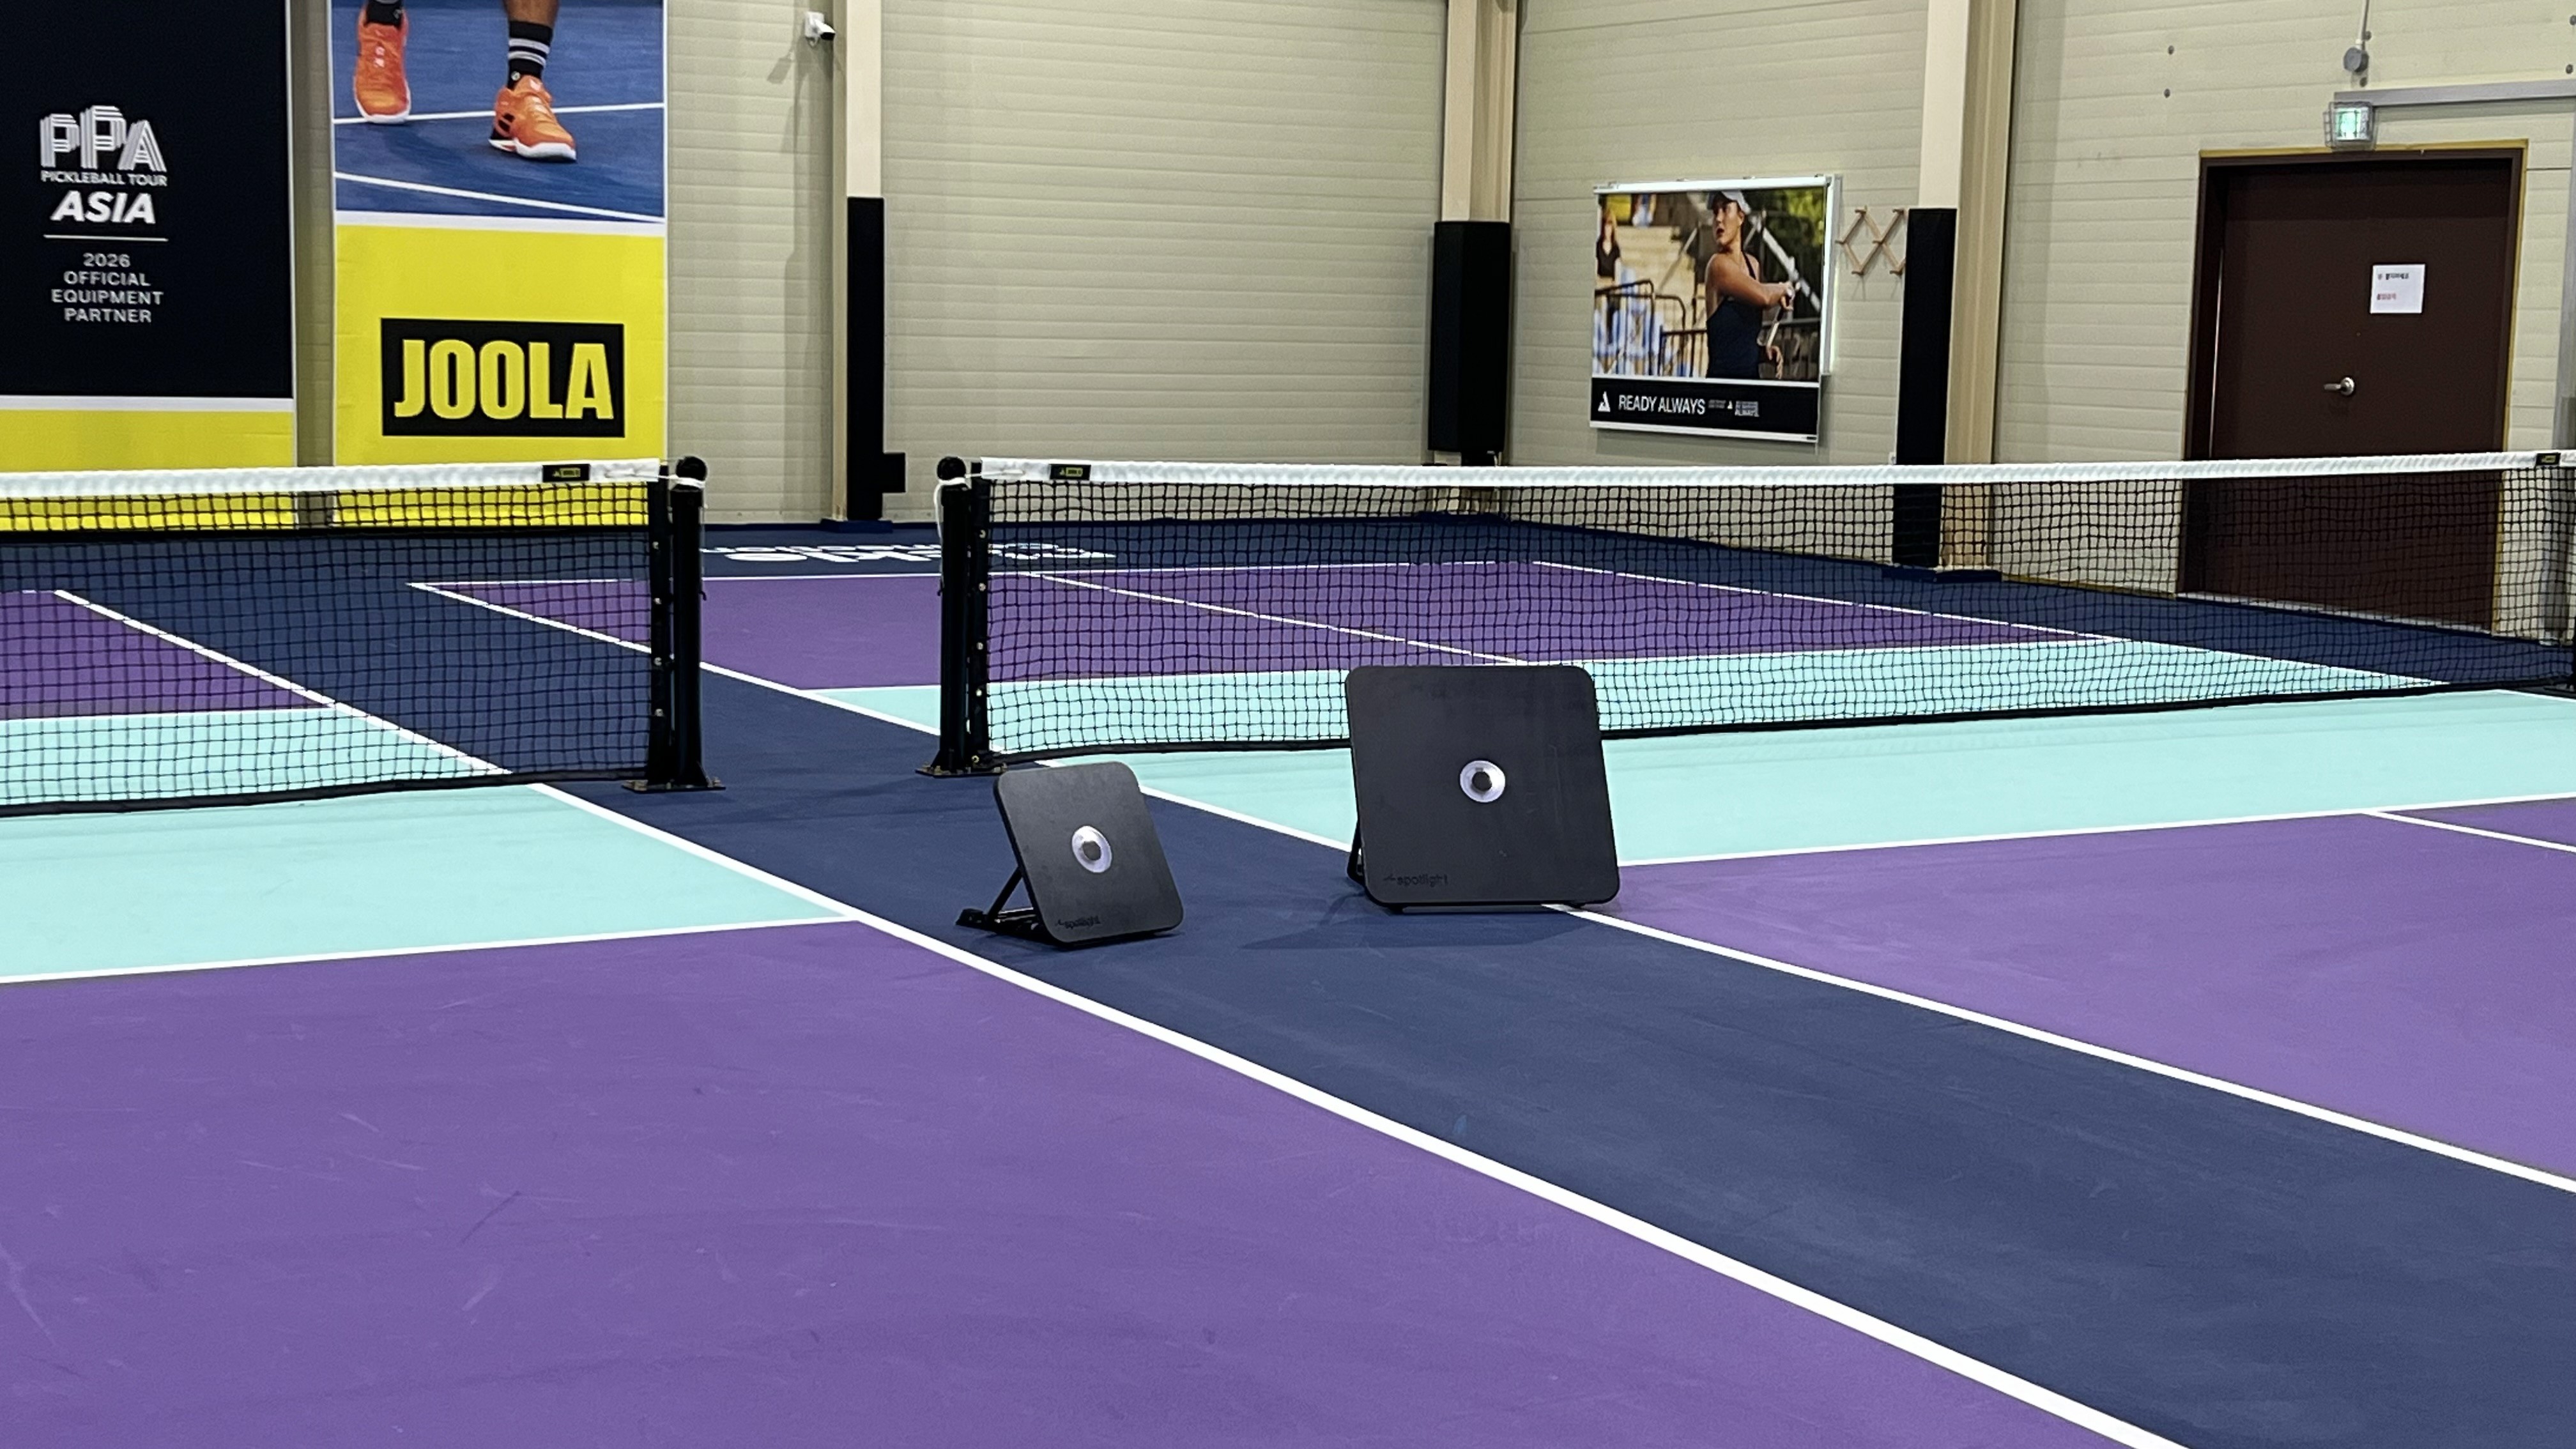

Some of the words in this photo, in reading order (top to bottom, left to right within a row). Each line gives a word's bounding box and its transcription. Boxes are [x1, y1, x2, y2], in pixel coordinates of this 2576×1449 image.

[40, 105, 167, 172] PPA
[40, 170, 126, 185] PICKLEBALL
[127, 173, 167, 187] TOUR
[50, 190, 156, 224] ASIA
[82, 252, 130, 267] 2026
[64, 271, 151, 286] OFFICIAL
[51, 289, 164, 305] EQUIPMENT
[65, 308, 152, 323] PARTNER
[394, 339, 614, 420] JOOLA
[1618, 394, 1657, 412] READY
[1657, 397, 1706, 415] ALWAYS
